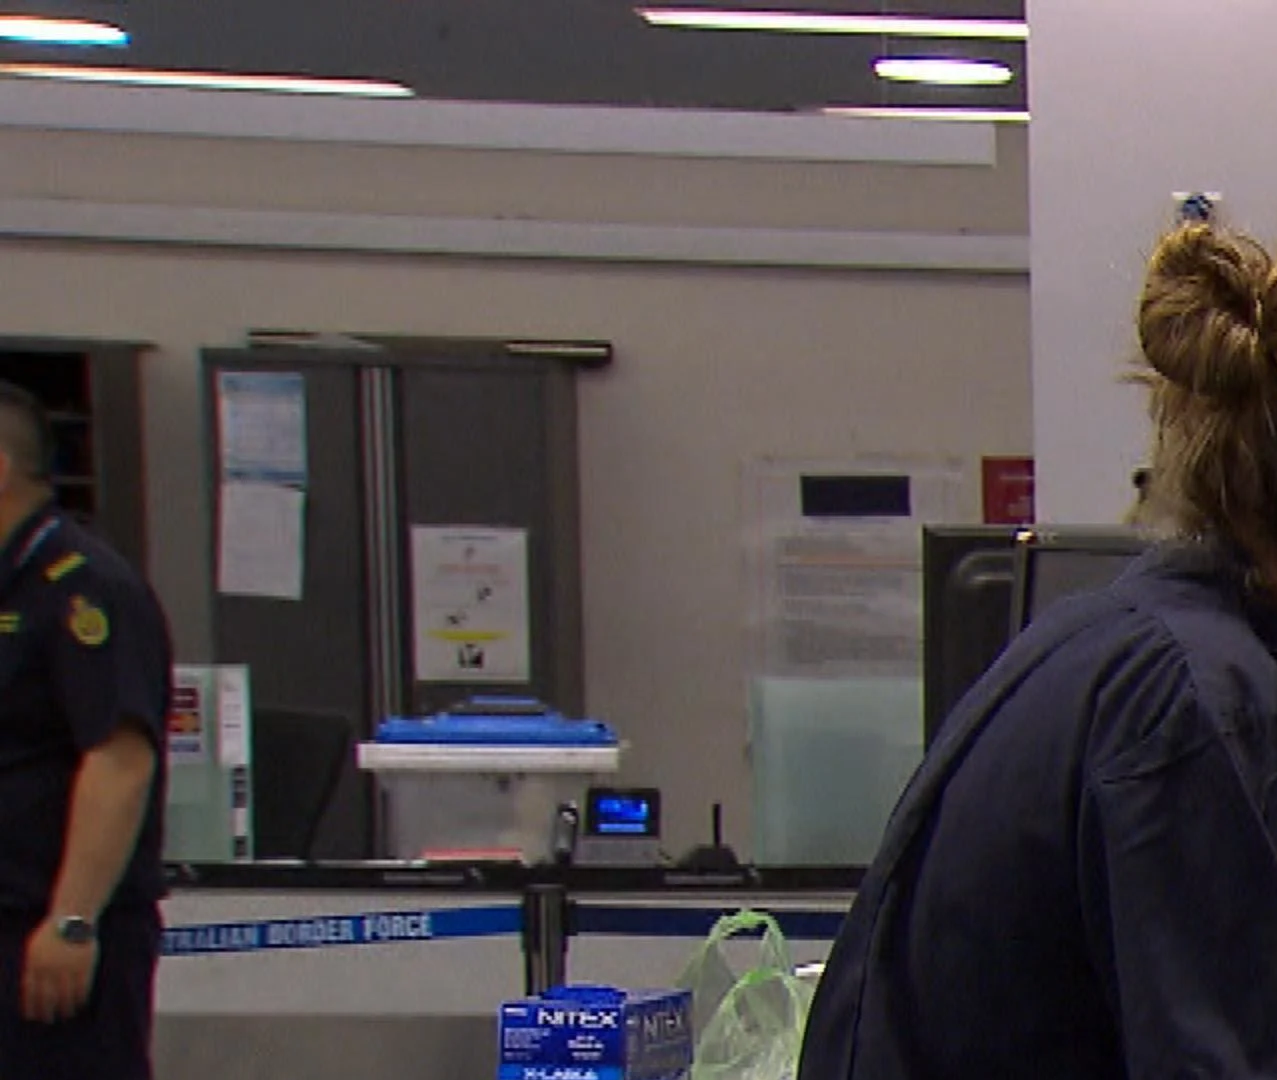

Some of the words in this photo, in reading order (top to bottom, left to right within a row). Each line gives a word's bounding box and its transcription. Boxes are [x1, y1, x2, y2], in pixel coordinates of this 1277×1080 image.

[268, 920, 354, 945] BORDER
[363, 915, 433, 938] FORCE
[537, 1009, 619, 1029] NITEX
